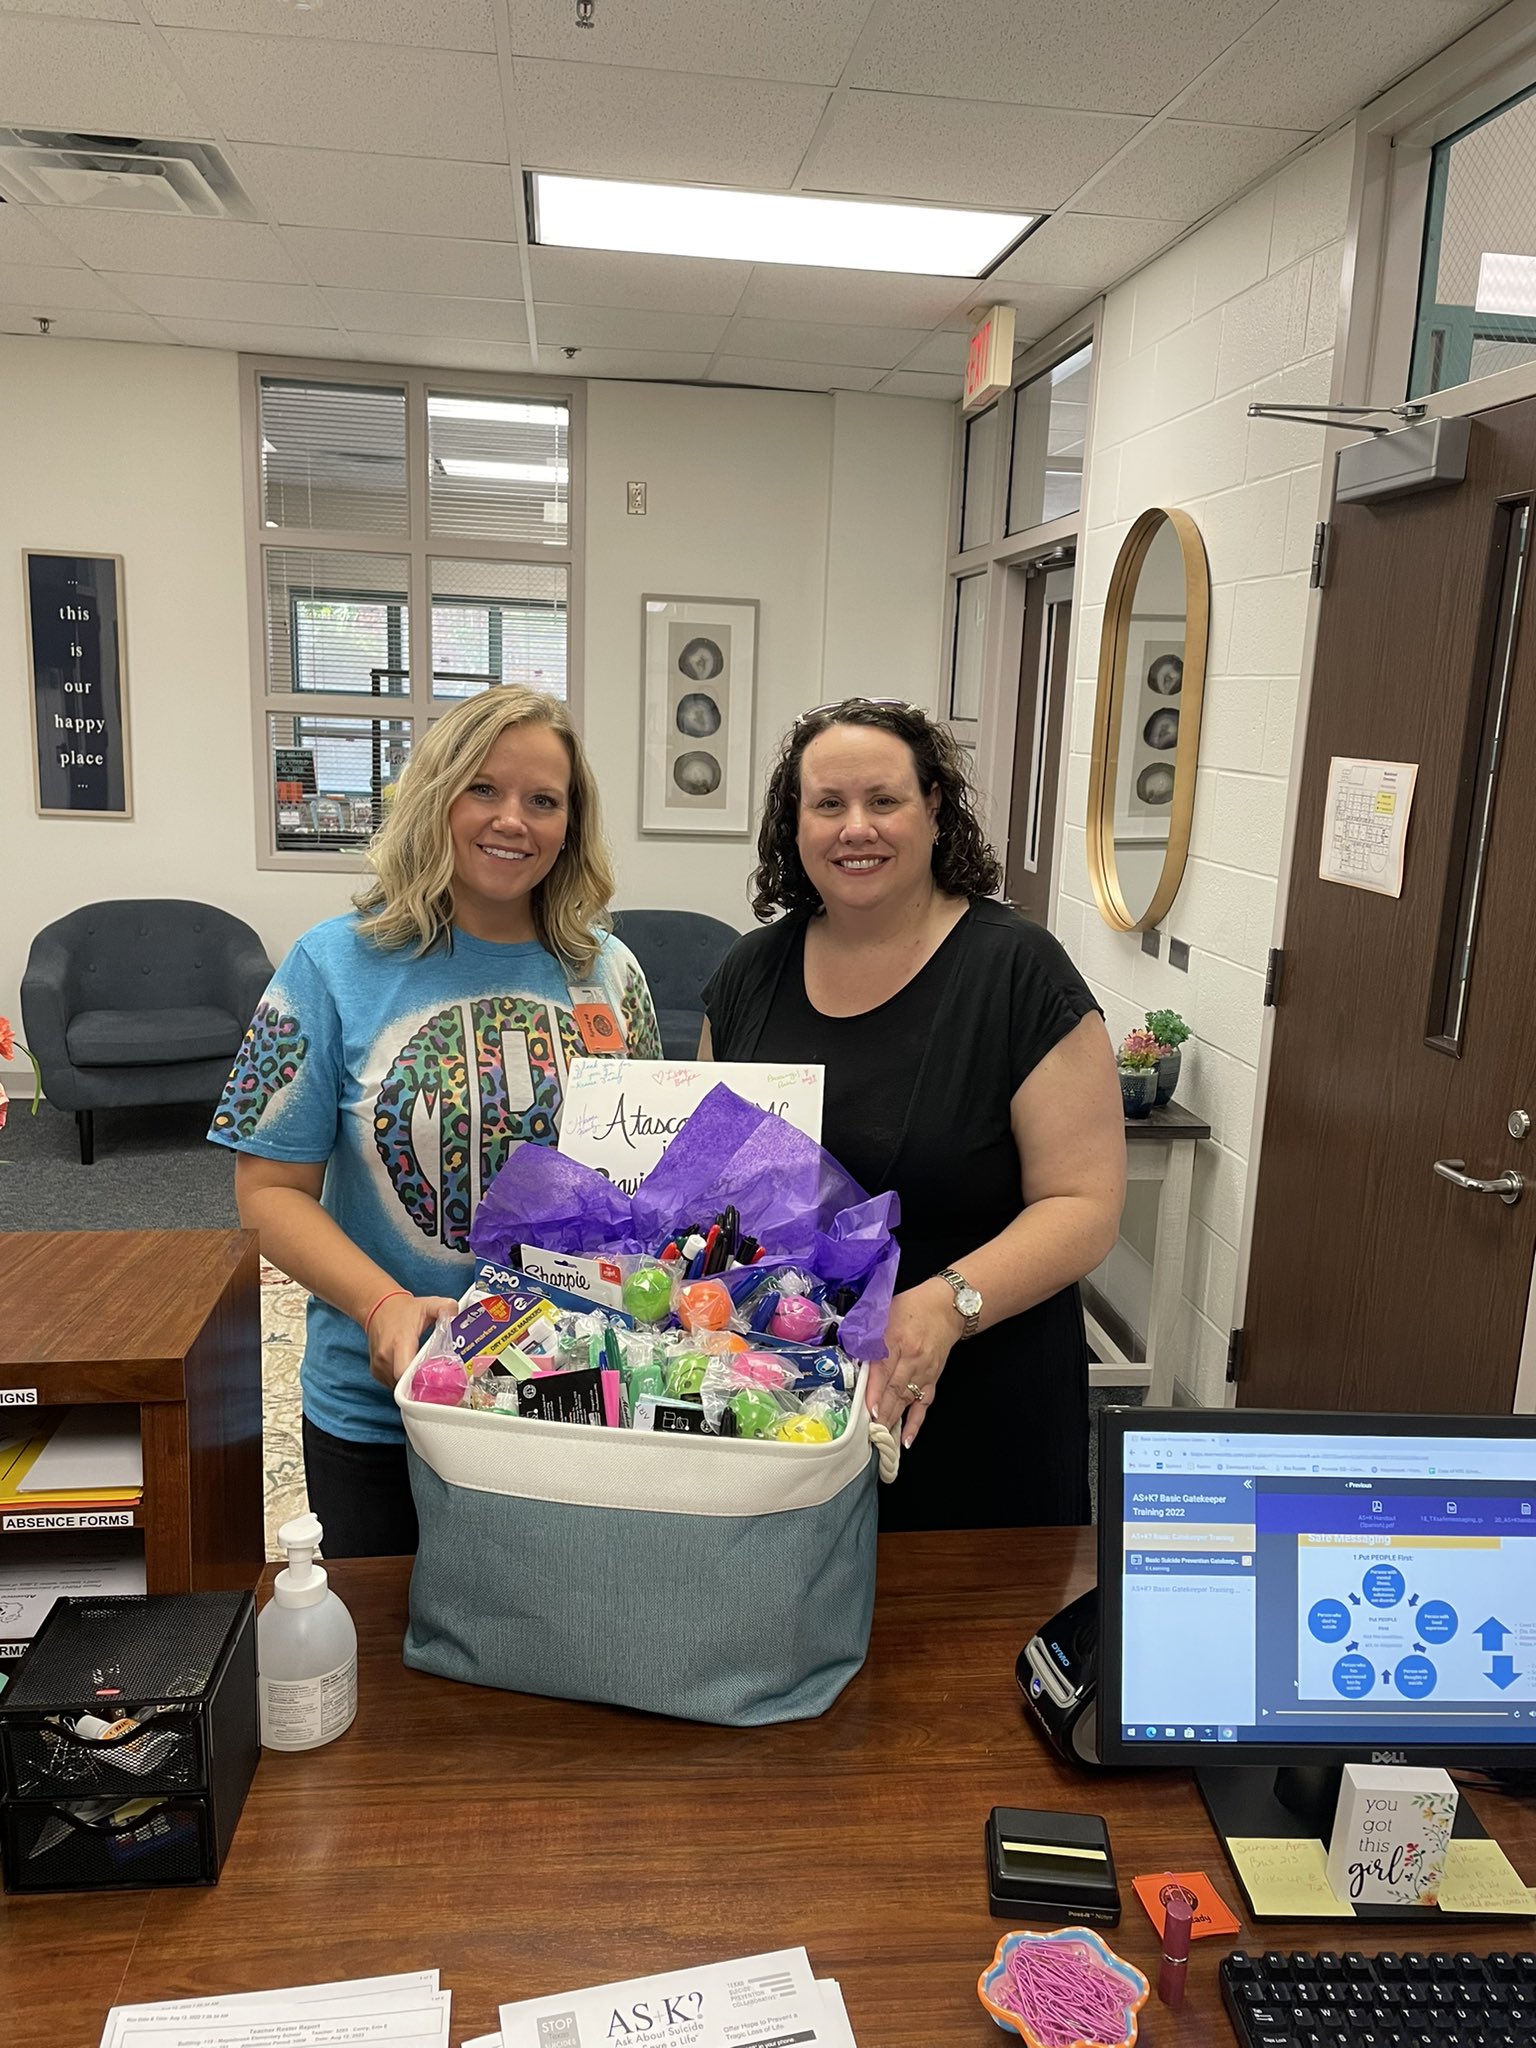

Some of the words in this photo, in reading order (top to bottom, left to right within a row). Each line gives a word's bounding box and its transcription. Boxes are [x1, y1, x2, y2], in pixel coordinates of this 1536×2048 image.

[59, 605, 90, 622] this
[70, 641, 83, 658] is
[64, 679, 92, 695] our
[55, 713, 106, 733] happy
[60, 749, 104, 768] place
[479, 1265, 520, 1289] EXPO
[524, 1265, 590, 1290] Sharpie
[475, 1325, 498, 1344] markers
[490, 1340, 503, 1351] DRY
[501, 1326, 520, 1342] ERASE
[517, 1308, 543, 1330] MARKERS
[0, 1393, 35, 1403] IGNS
[1133, 1494, 1158, 1503] AS+K?
[1160, 1494, 1181, 1503] Basic
[1183, 1495, 1227, 1505] Gatekeeper
[1133, 1508, 1164, 1518] Training
[1166, 1508, 1185, 1517] 2022
[6, 1517, 75, 1528] ABSENCE
[79, 1515, 129, 1526] FORMS
[1145, 1556, 1160, 1564] Basic
[1371, 1554, 1397, 1562] PEOPLE
[1050, 1642, 1071, 1668] DYMO
[1372, 1752, 1406, 1764] DELL
[1366, 1798, 1397, 1813] you
[1363, 1819, 1392, 1834] got
[1360, 1838, 1390, 1853] this
[1348, 1845, 1407, 1898] girl
[727, 1980, 745, 1988] TEXAS
[729, 1986, 751, 1995] SUICIDE
[730, 1990, 766, 2002] PREVENTION
[605, 1991, 704, 2038] AS+K?
[1294, 2009, 1303, 2017] Q
[1348, 2010, 1358, 2018] E
[1375, 2010, 1385, 2018] R
[1402, 2010, 1411, 2018] T
[1430, 2010, 1439, 2018] Y
[1458, 2010, 1467, 2019] U
[1512, 2010, 1522, 2019] O
[542, 2018, 573, 2034] STOP
[723, 2025, 740, 2034] Offer
[741, 2022, 759, 2030] Hope
[768, 2014, 793, 2024] Prevent
[615, 2036, 634, 2048] Ask
[636, 2031, 667, 2044] About
[668, 2023, 705, 2038] Suicide
[725, 2031, 747, 2041] Tragic
[748, 2029, 763, 2037] Loss
[764, 2026, 771, 2034] of
[1311, 2034, 1320, 2042] A
[1338, 2034, 1347, 2042] S
[1366, 2034, 1375, 2043] D
[1392, 2034, 1401, 2042] F
[1422, 2035, 1431, 2044] G
[1448, 2035, 1459, 2044] H
[1478, 2036, 1485, 2044] J
[1504, 2036, 1514, 2044] K
